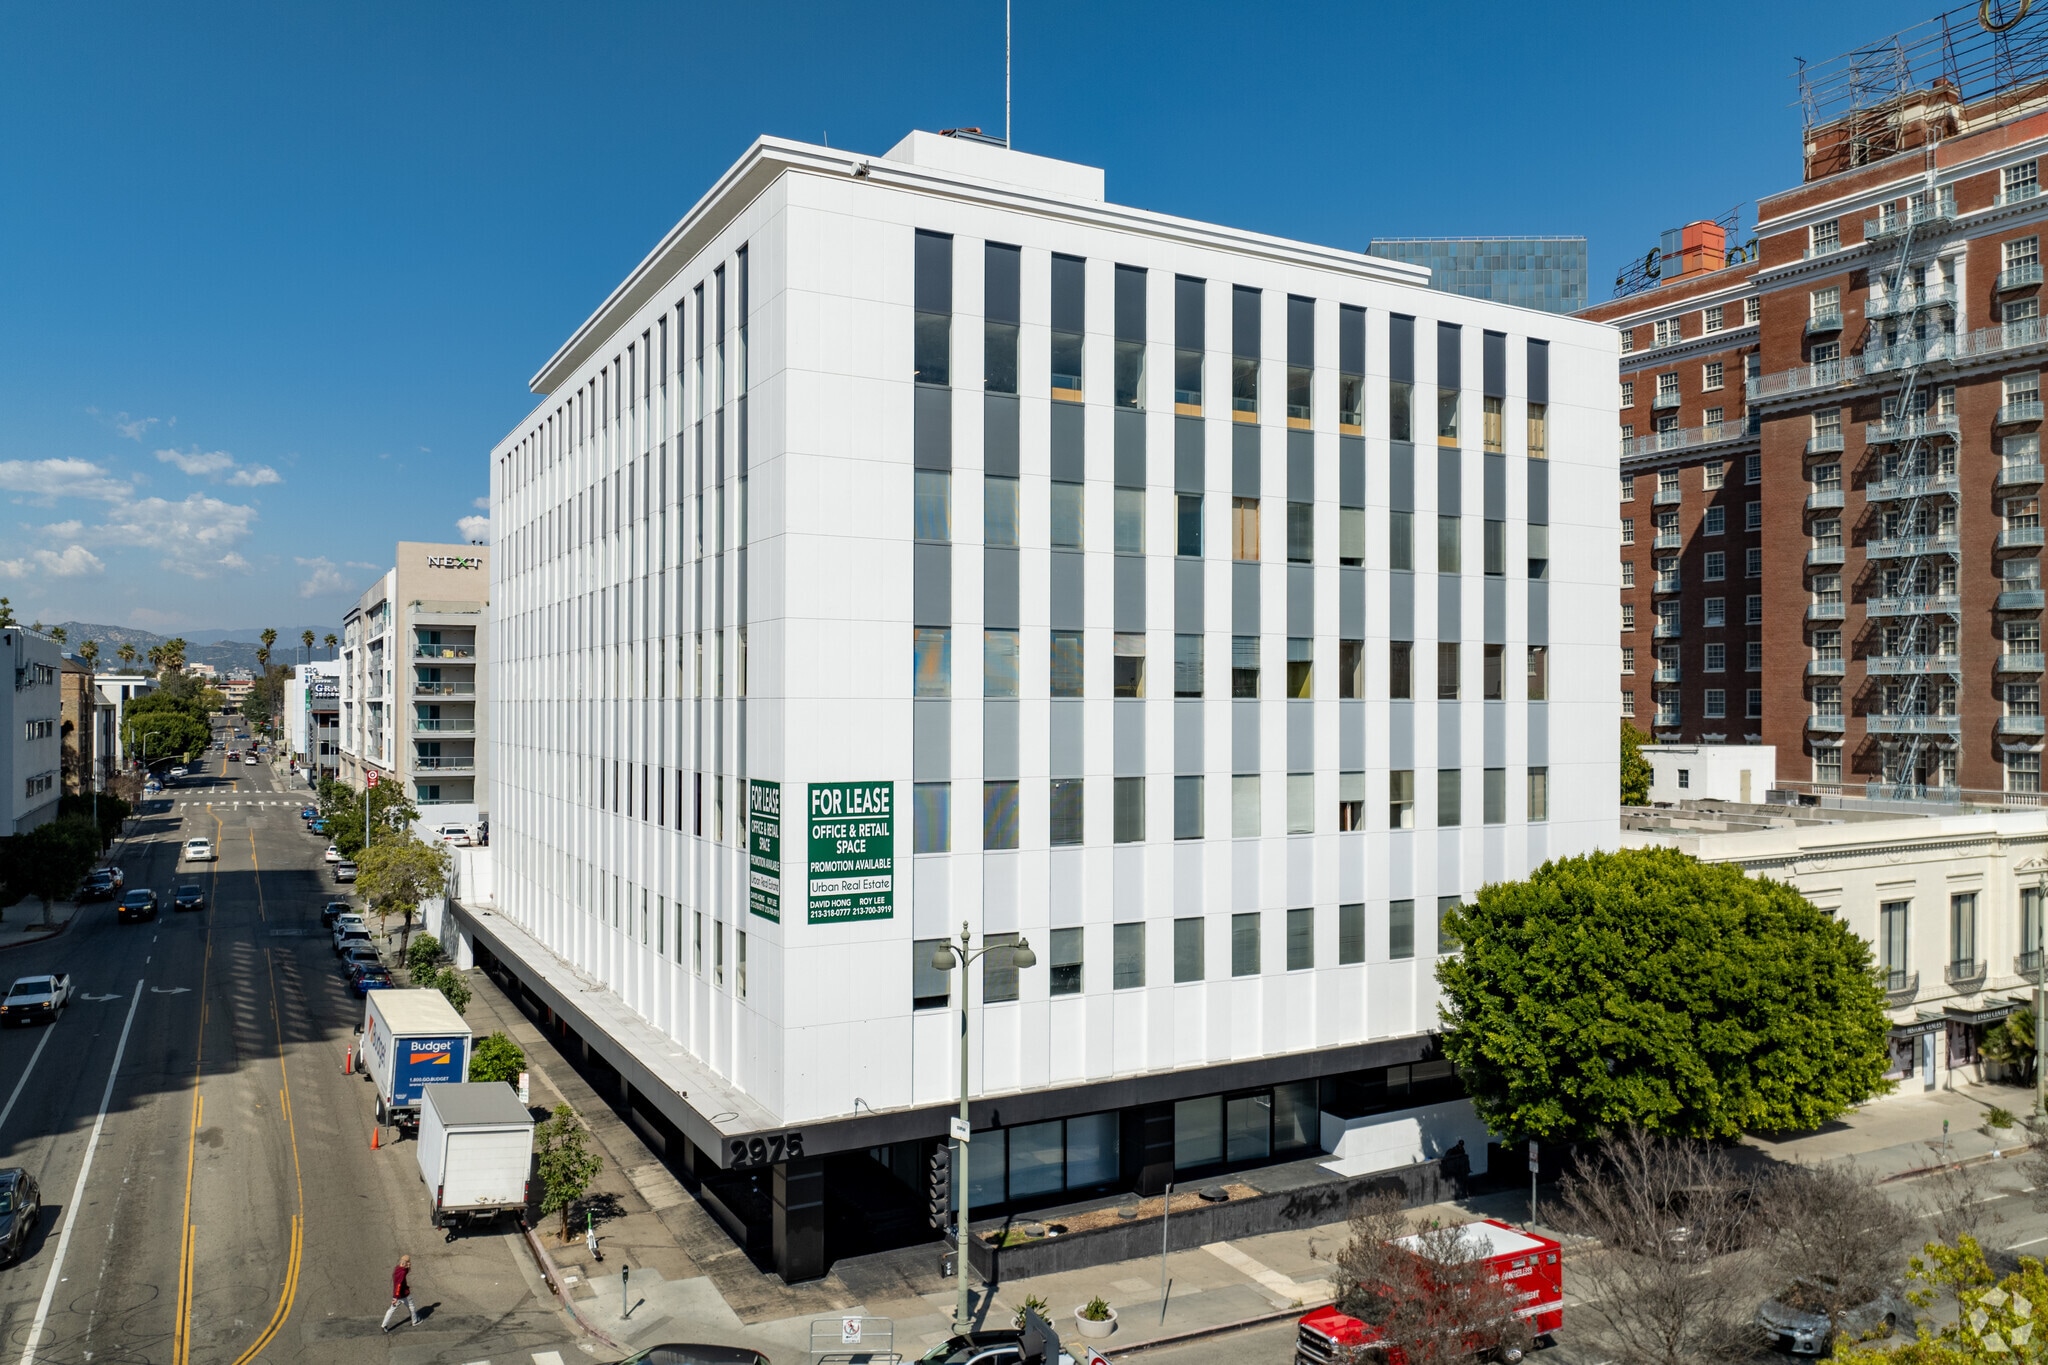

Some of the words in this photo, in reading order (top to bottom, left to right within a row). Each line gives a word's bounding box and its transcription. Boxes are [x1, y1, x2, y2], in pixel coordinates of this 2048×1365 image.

[428, 555, 481, 567] NEXT
[751, 785, 762, 812] FOR
[763, 787, 779, 815] LEASE
[812, 789, 842, 815] FOR
[846, 787, 890, 814] LEASE
[812, 824, 846, 839] OFFICE
[849, 824, 857, 837] &
[859, 823, 890, 837] RETAIL
[836, 839, 866, 854] SPACE
[810, 860, 854, 873] PROMOTION
[855, 858, 891, 870] AVAILABLE
[811, 881, 839, 893] Urban
[841, 879, 861, 891] Real
[863, 878, 890, 890] Estate
[810, 900, 830, 909] DAVID
[831, 898, 851, 908] HONG
[859, 897, 872, 906] ROY
[873, 896, 885, 904] LEE
[810, 908, 851, 918] 213-318-0777
[852, 906, 892, 915] 213-700-3919
[411, 1041, 451, 1053] Budget
[730, 1132, 804, 1170] 2975
